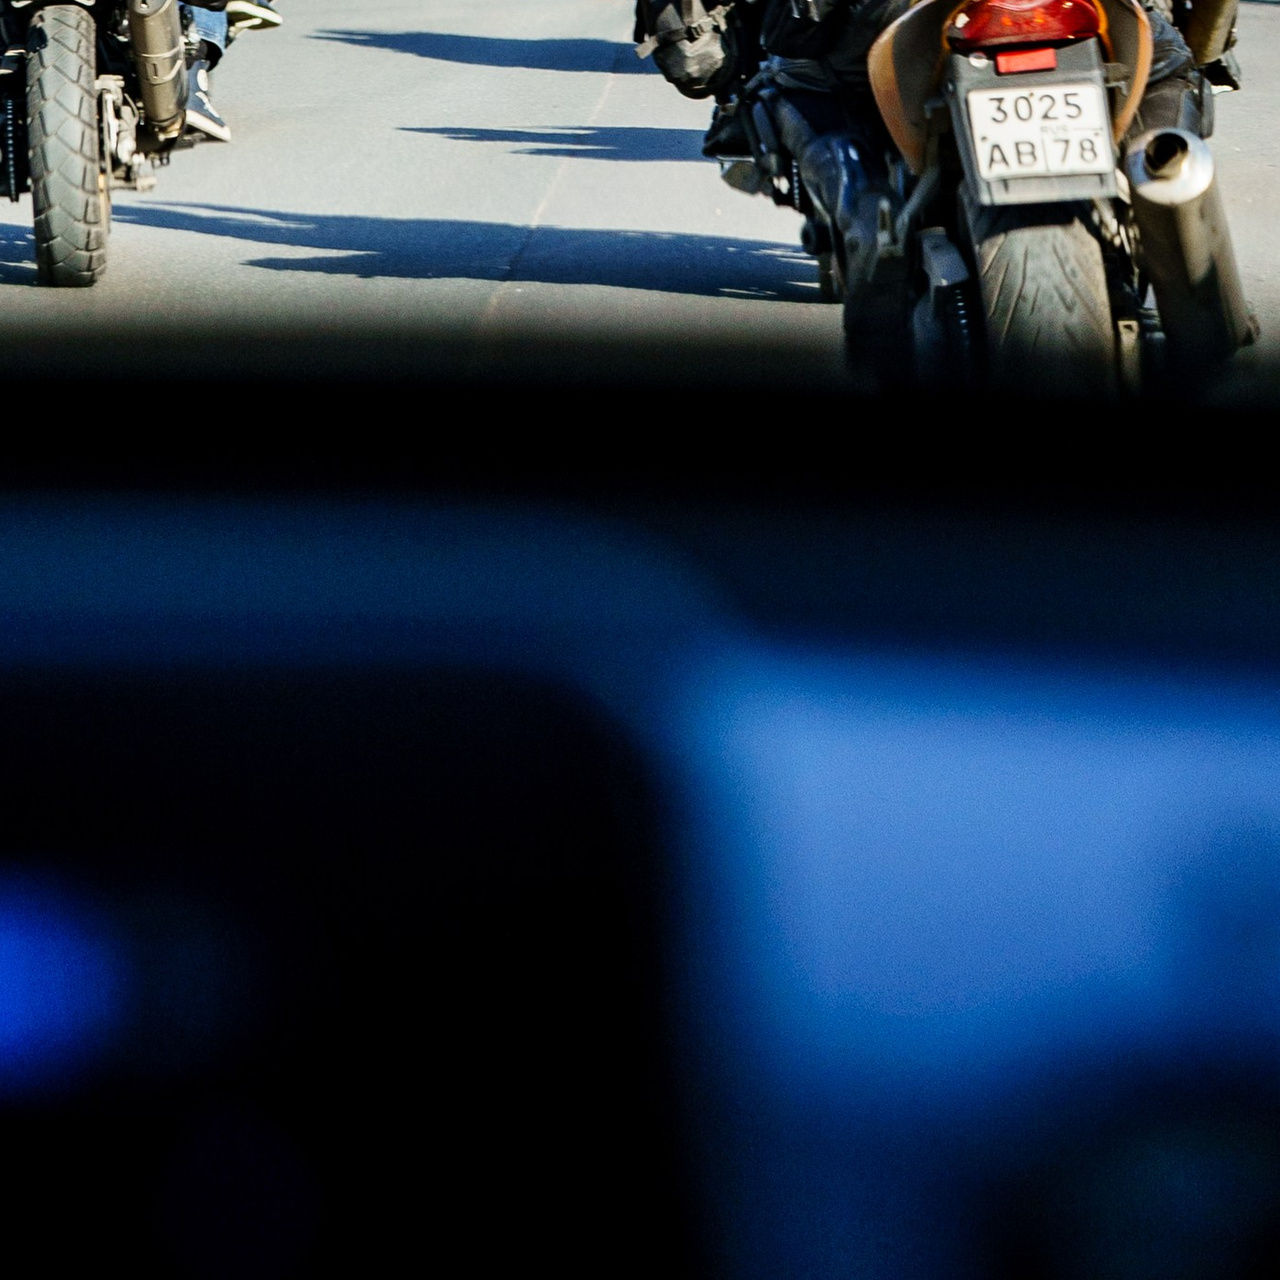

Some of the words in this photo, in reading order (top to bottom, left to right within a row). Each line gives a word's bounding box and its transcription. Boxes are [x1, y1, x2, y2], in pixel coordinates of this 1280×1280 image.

[988, 92, 1082, 124] 3025
[988, 140, 1038, 171] АВ
[1055, 138, 1098, 165] 78
